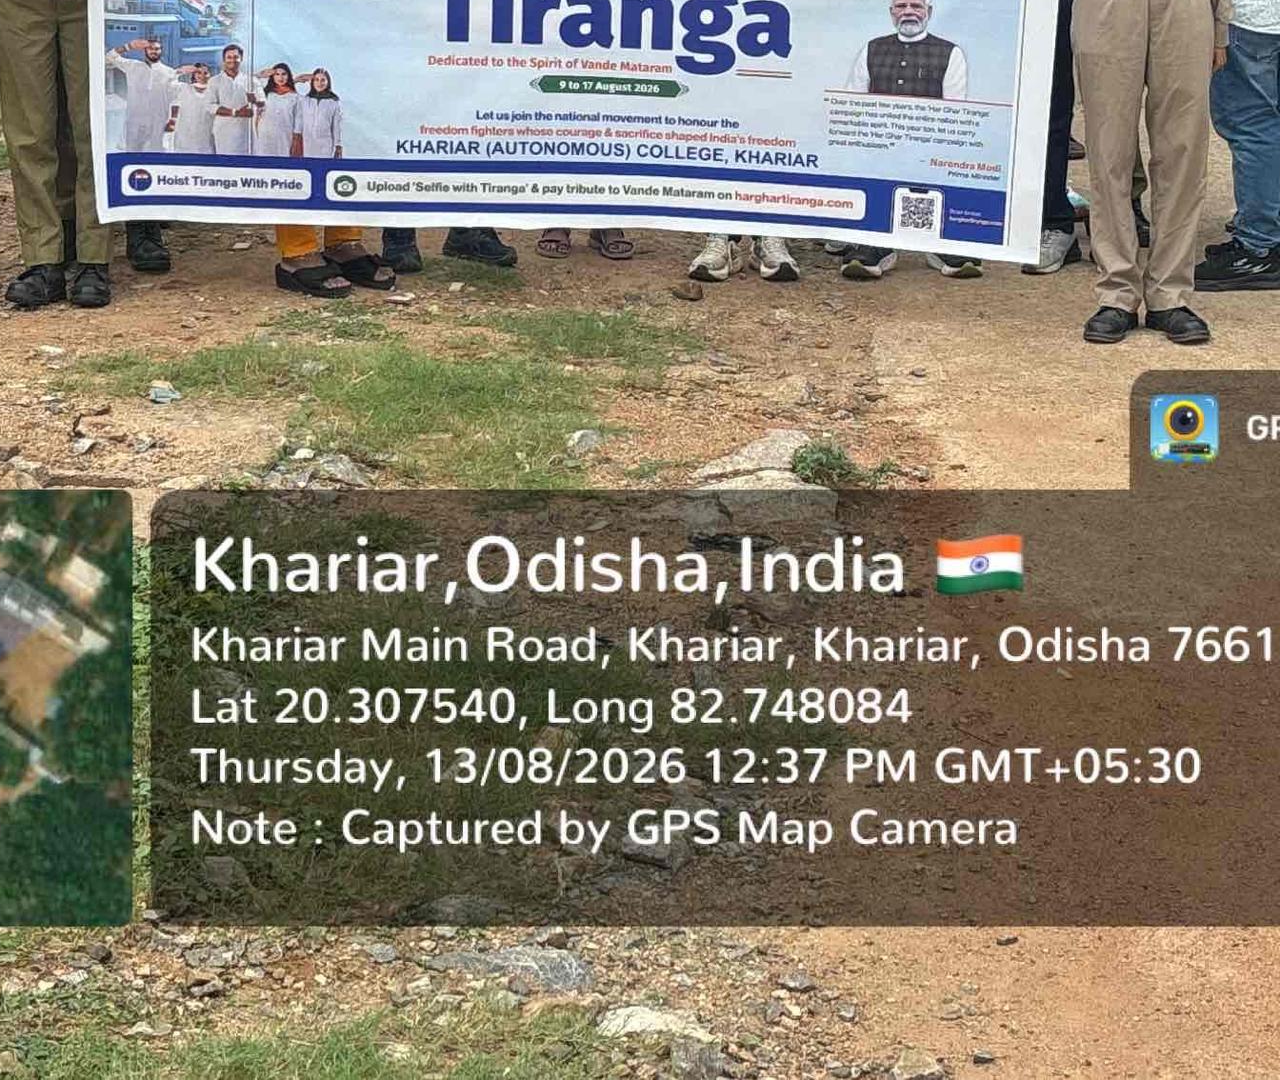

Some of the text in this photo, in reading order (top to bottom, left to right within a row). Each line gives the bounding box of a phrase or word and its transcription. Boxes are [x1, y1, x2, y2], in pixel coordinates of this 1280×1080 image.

[428, 55, 673, 74] Dedicated to the Spirit of Vande Mataram
[559, 80, 660, 96] 9 to 17 August 2026
[476, 110, 740, 129] Let us join the national movement to honour the
[420, 125, 796, 148] freedom fighters whose courage & sacrifice shaped India's freedom
[396, 139, 819, 169] KHARIAR (AUTONOMOUS) COLLEGE, KHARIAR
[930, 158, 976, 170] Narendra
[157, 175, 303, 191] Hoist Tiranga With Pride
[367, 181, 854, 210] Upload 'Selfie with Tiranga' & pay tribute to Vande Mataram on harghartiranga.com
